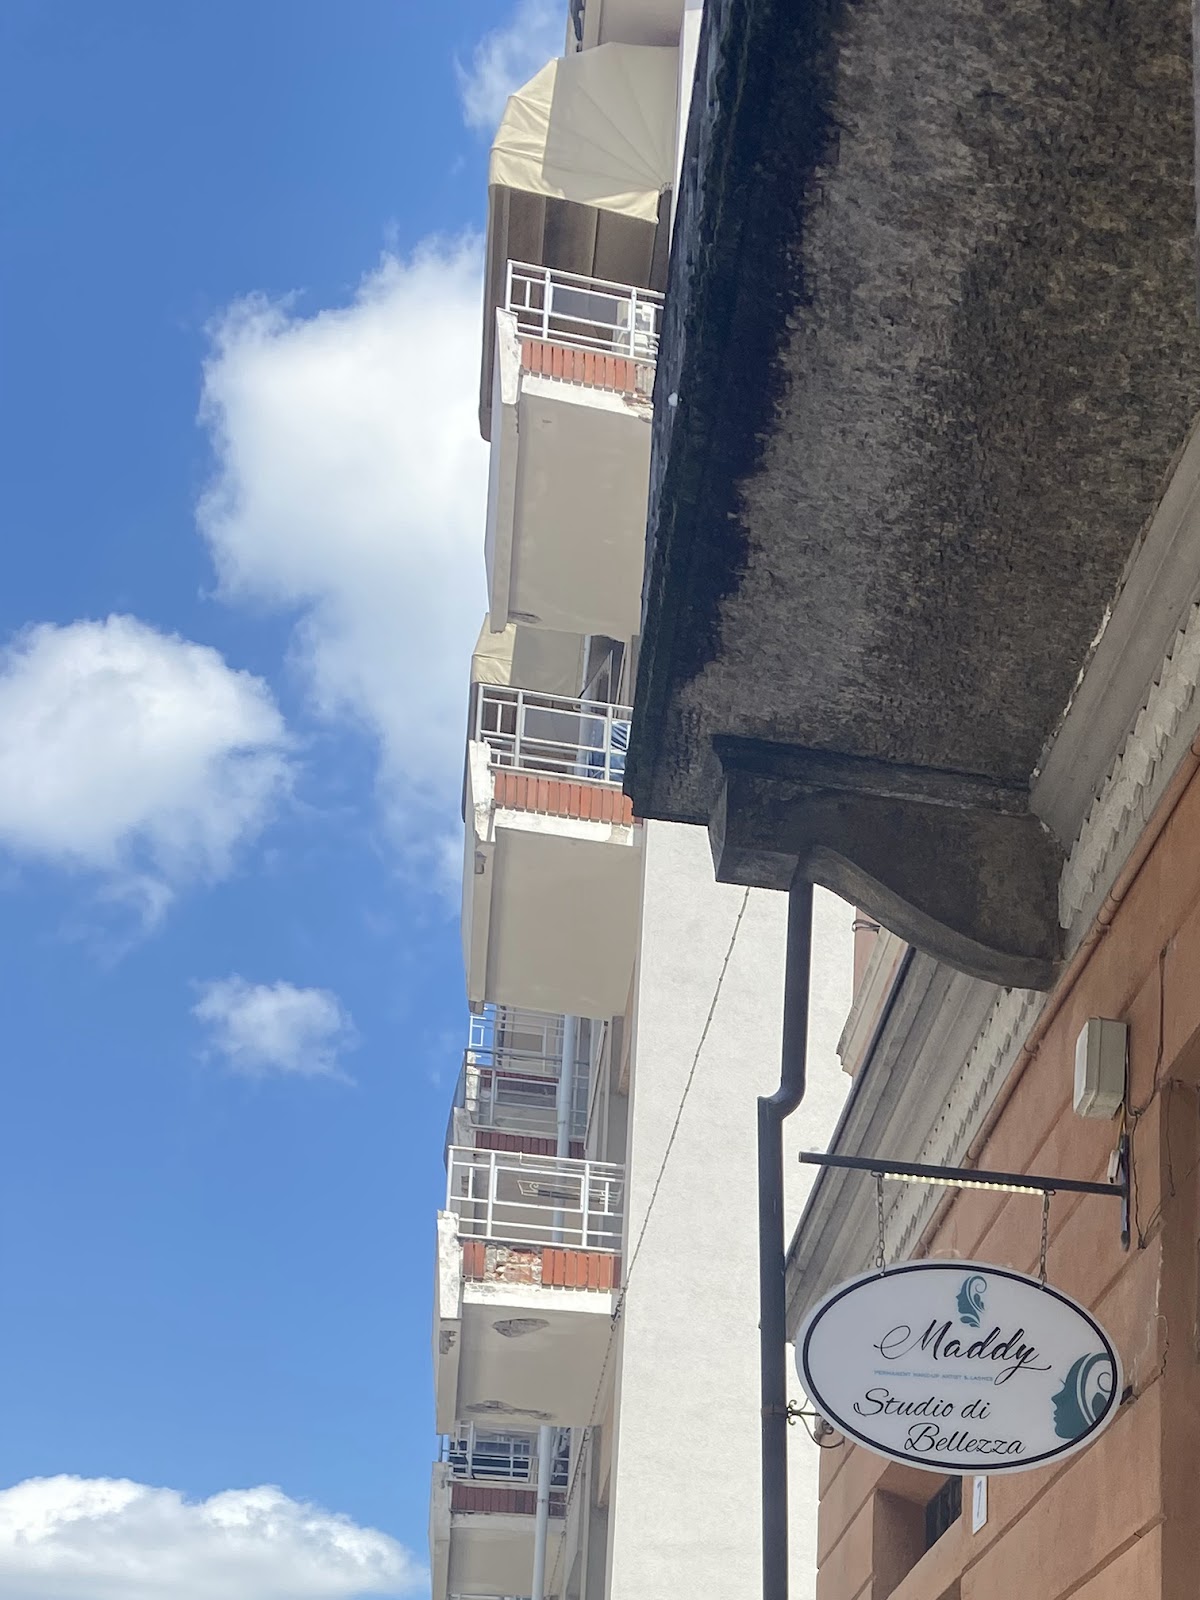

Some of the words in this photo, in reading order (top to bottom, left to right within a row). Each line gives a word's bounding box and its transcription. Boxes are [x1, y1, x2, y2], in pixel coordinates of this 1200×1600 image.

[874, 1319, 1052, 1386] Maddy
[853, 1387, 954, 1417] Studio
[961, 1399, 991, 1420] di
[904, 1422, 1027, 1455] Bellezza
